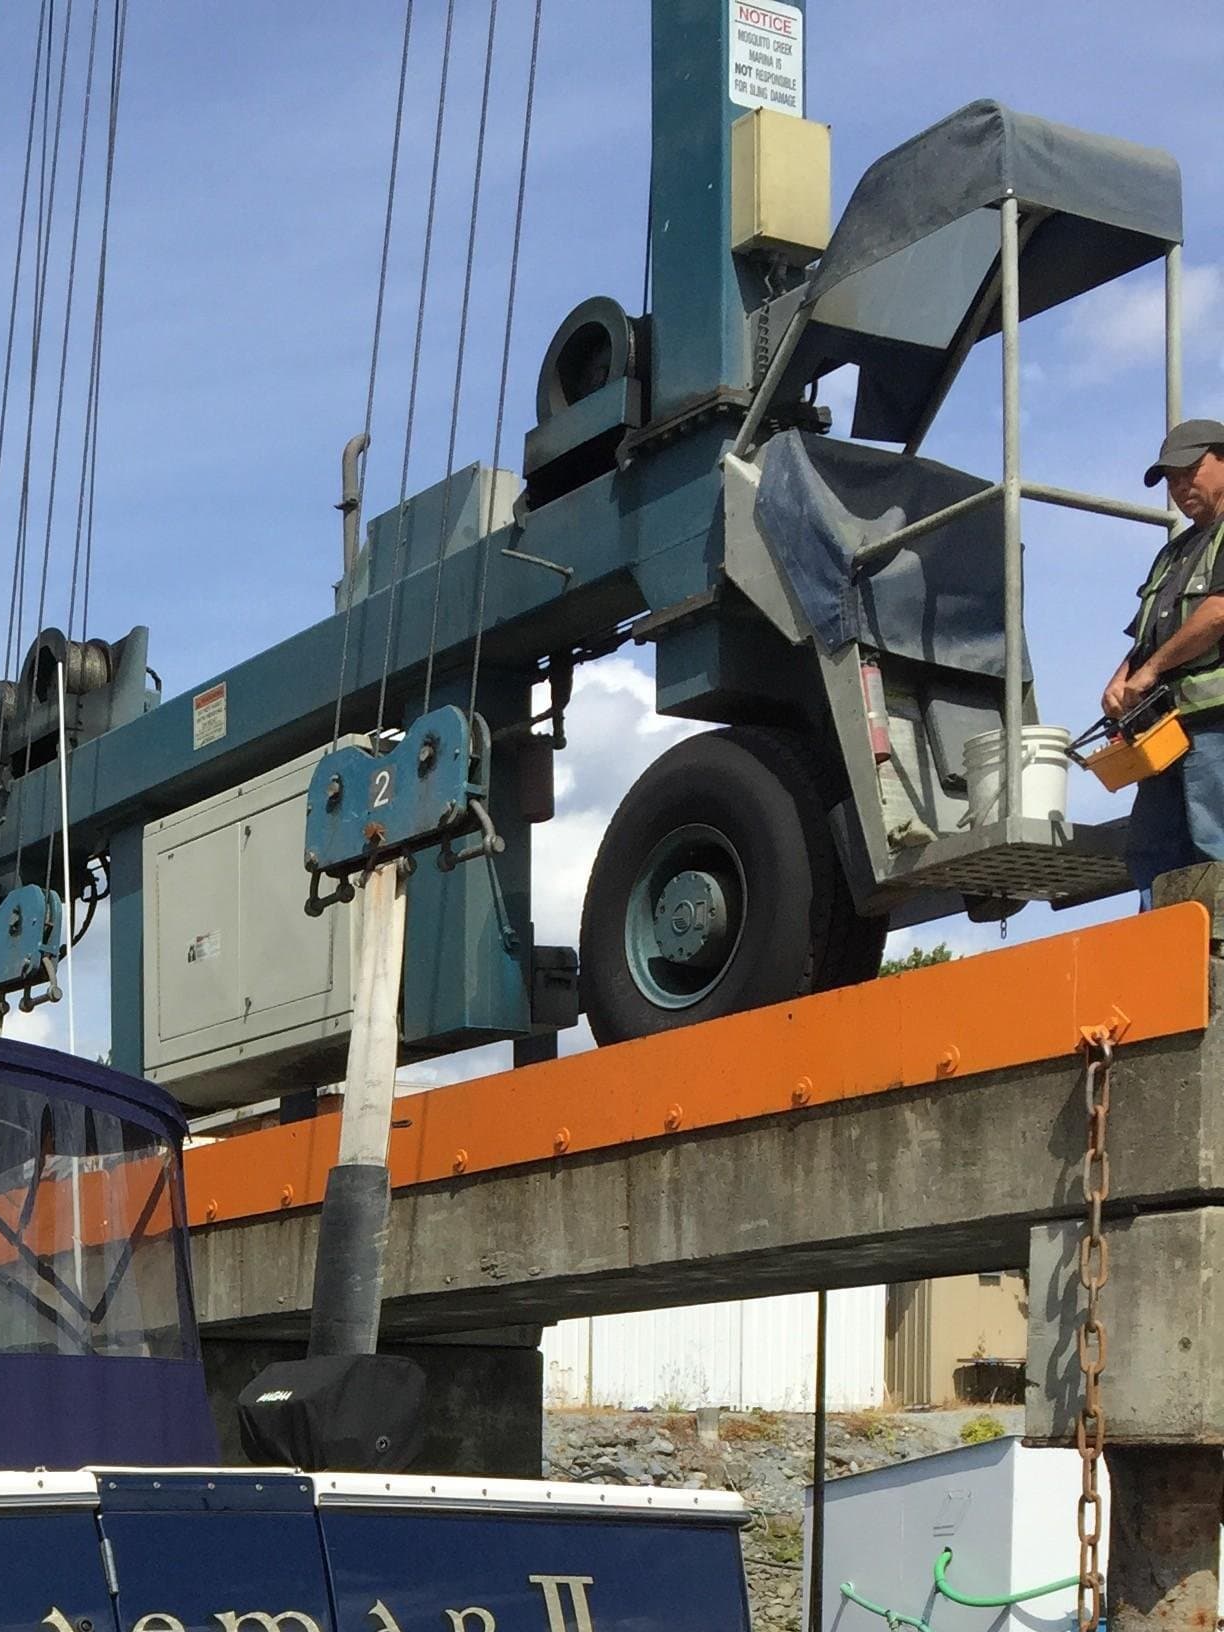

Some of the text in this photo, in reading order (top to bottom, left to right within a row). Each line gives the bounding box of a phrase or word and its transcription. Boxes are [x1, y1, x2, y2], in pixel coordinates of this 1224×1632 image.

[739, 6, 792, 34] NOTICE
[738, 29, 792, 56] MOSQUITO CREEK
[749, 49, 782, 70] MARINA IS
[735, 62, 796, 91] NOT RESPONSIBLE
[735, 79, 747, 94] FOR
[750, 84, 768, 100] SLING
[374, 771, 389, 808] 2
